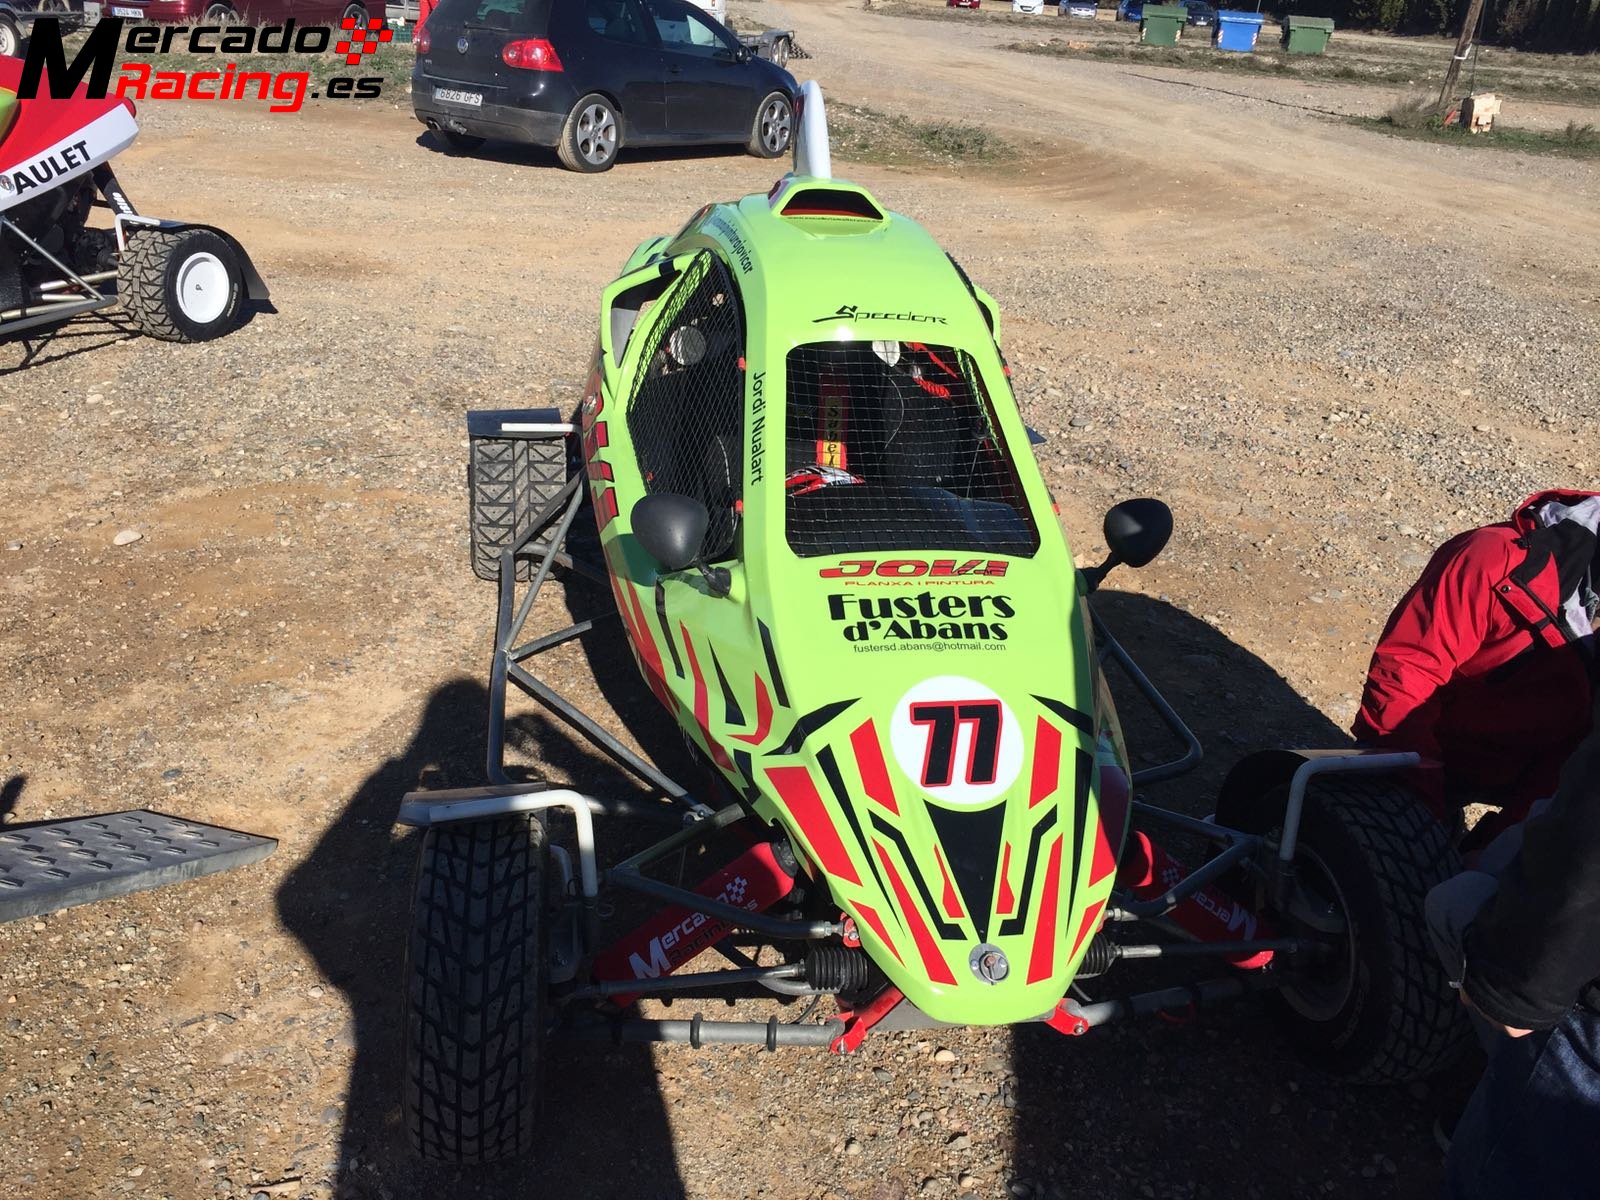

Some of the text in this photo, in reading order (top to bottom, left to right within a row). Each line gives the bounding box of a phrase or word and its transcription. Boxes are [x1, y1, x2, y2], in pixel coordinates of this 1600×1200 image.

[441, 89, 461, 101] 6826
[12, 140, 91, 195] AULET
[751, 372, 767, 486] Jordi Nualart
[828, 591, 1015, 620] Fusters
[854, 642, 1006, 653] fustersd.abans@hotmail.com
[909, 699, 1003, 787] 77
